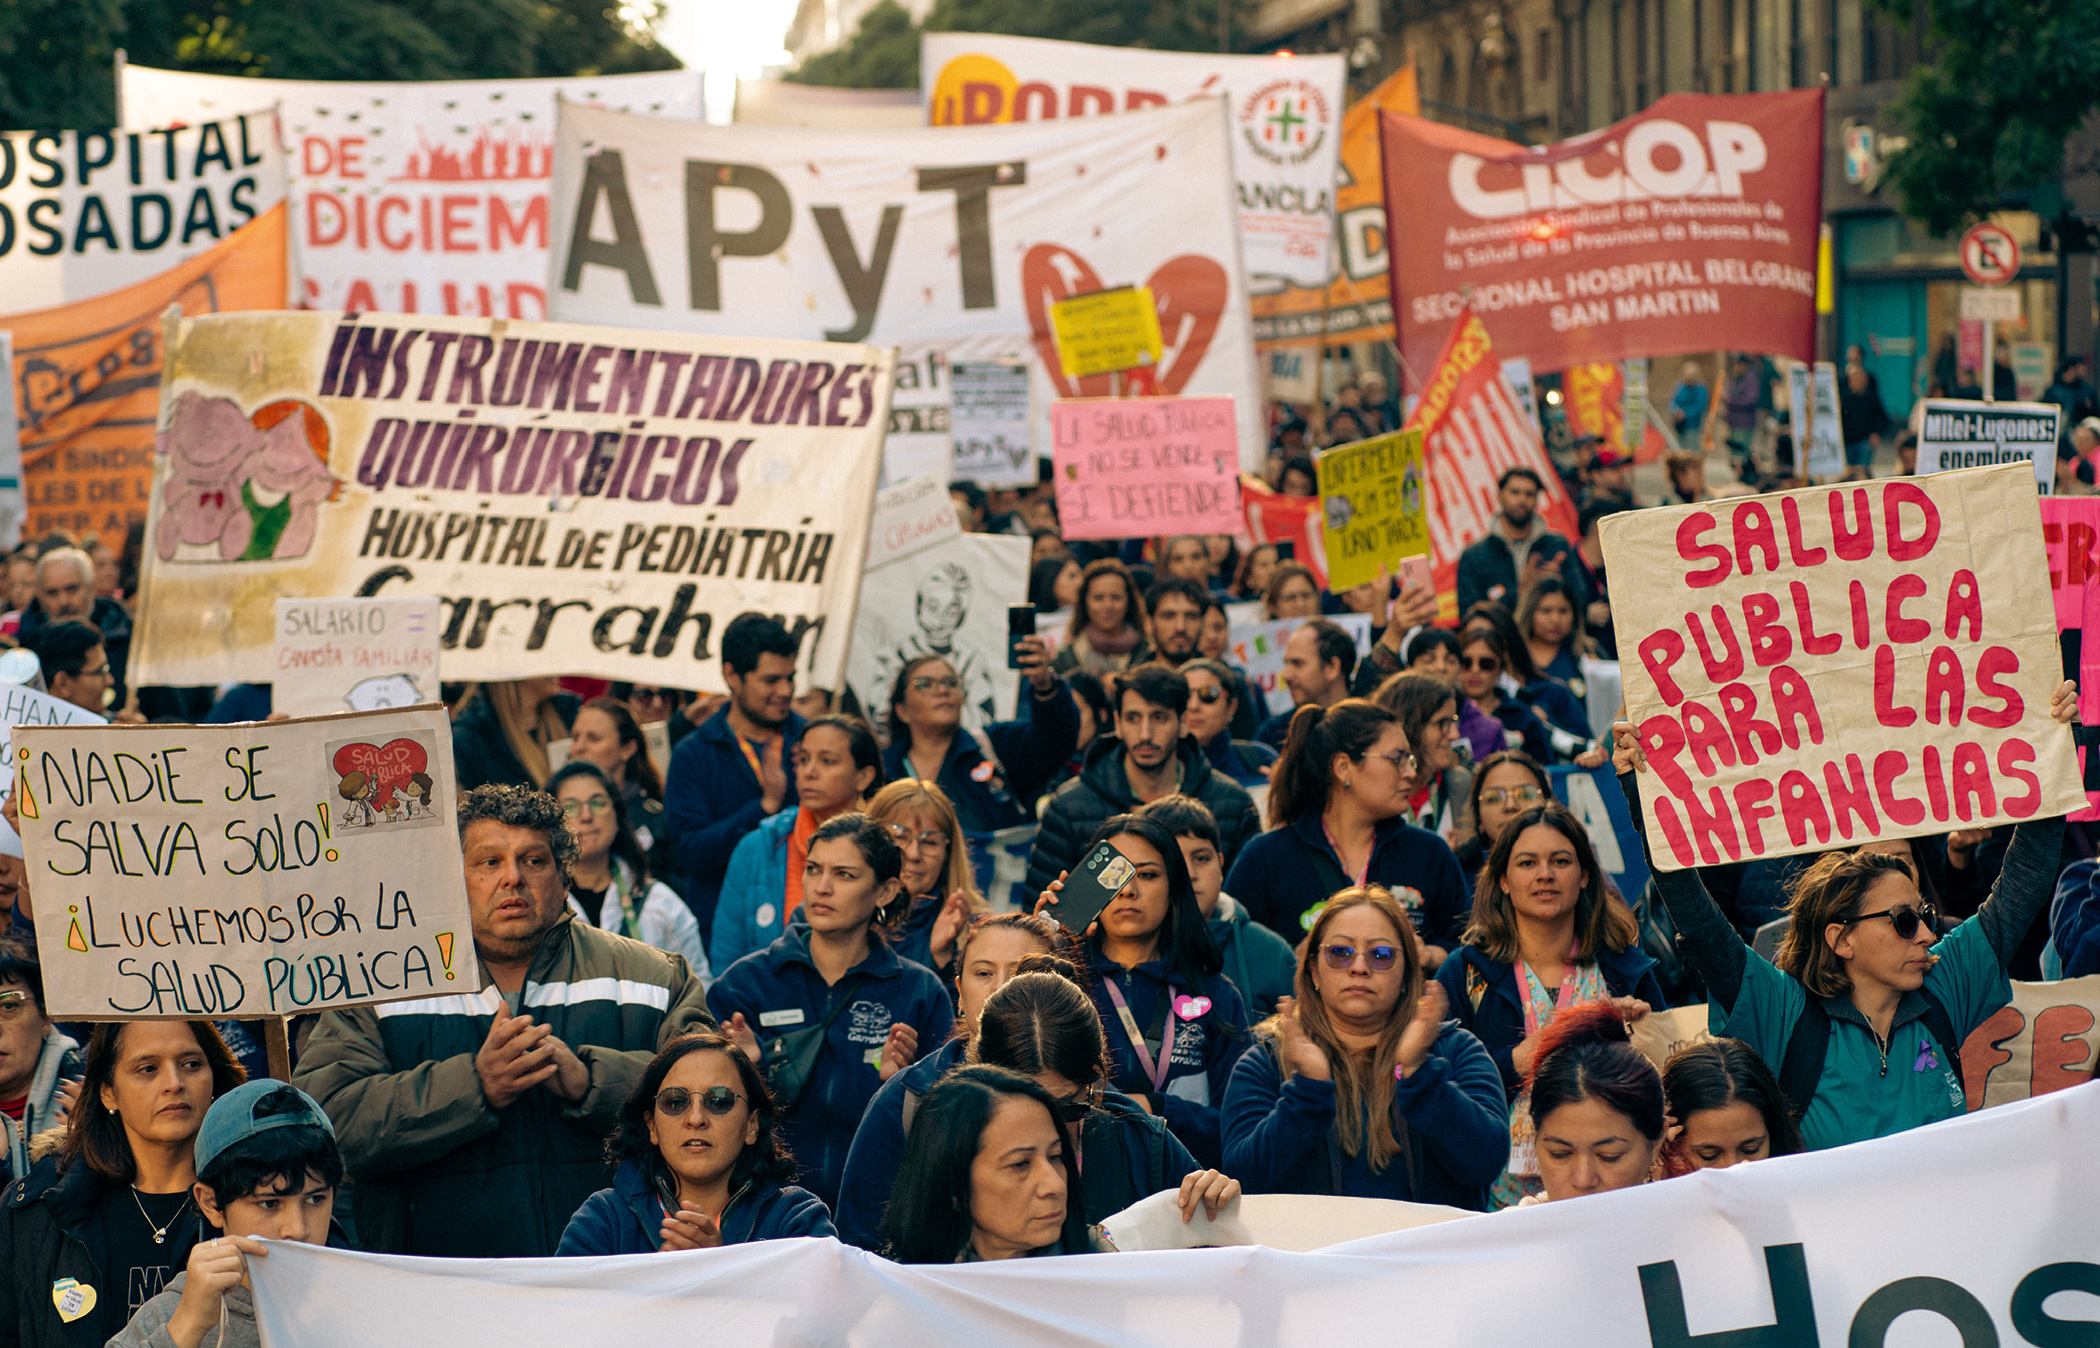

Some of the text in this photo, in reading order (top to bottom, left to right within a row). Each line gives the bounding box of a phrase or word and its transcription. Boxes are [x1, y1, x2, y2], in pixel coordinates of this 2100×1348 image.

[303, 137, 367, 178] DE
[308, 192, 549, 253] DICIEM
[1651, 200, 1762, 220] Profesionales
[562, 149, 1026, 343] APyT
[1463, 243, 1519, 267] Salud
[1688, 219, 1750, 241] Buenos
[1752, 222, 1791, 246] Aires
[1412, 276, 1564, 323] SECIONAL
[1565, 258, 1702, 298] HOSPITAL
[1551, 288, 1721, 332] SAN MARTIN
[319, 313, 884, 428] INSTRUMENTADORES
[1418, 315, 1493, 430] ADORES
[1087, 450, 1117, 474] NO
[1118, 449, 1142, 471] SE
[1060, 484, 1099, 525] SE
[358, 502, 549, 567] HOSPITAL
[554, 528, 614, 570] DE
[1675, 482, 1942, 589] SALUD
[284, 606, 387, 636] SALARIO
[353, 565, 827, 675] arrahn
[1637, 569, 1984, 708] PUBLICA
[0, 688, 73, 726] HAN
[1639, 644, 2026, 800] PARA LAS
[224, 745, 277, 802] SE
[351, 747, 411, 766] SALUD
[1653, 737, 2042, 867] INFANCIAS
[47, 801, 340, 877] SALVA SOLO!
[295, 892, 361, 938] POR
[375, 882, 417, 931] LA
[108, 958, 247, 1017] SALUD
[847, 1031, 889, 1045] Garraha
[1170, 1054, 1203, 1067] arrahan
